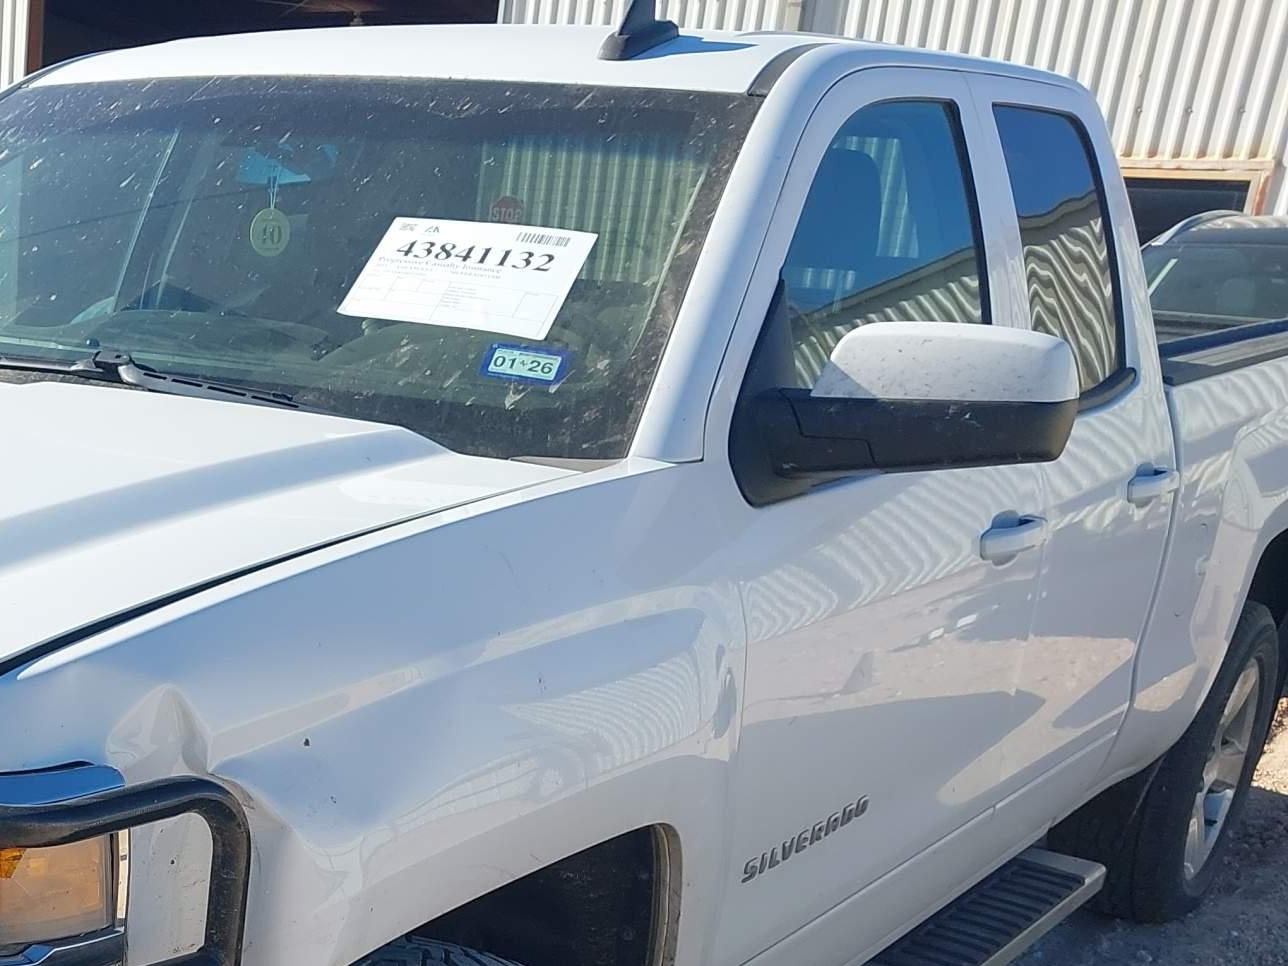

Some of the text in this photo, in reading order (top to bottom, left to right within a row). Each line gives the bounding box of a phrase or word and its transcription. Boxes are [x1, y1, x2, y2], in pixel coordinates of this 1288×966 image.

[492, 207, 522, 223] STOP
[396, 239, 555, 272] 43841132
[493, 355, 554, 374] 01 26
[740, 794, 870, 884] SILVERADO
